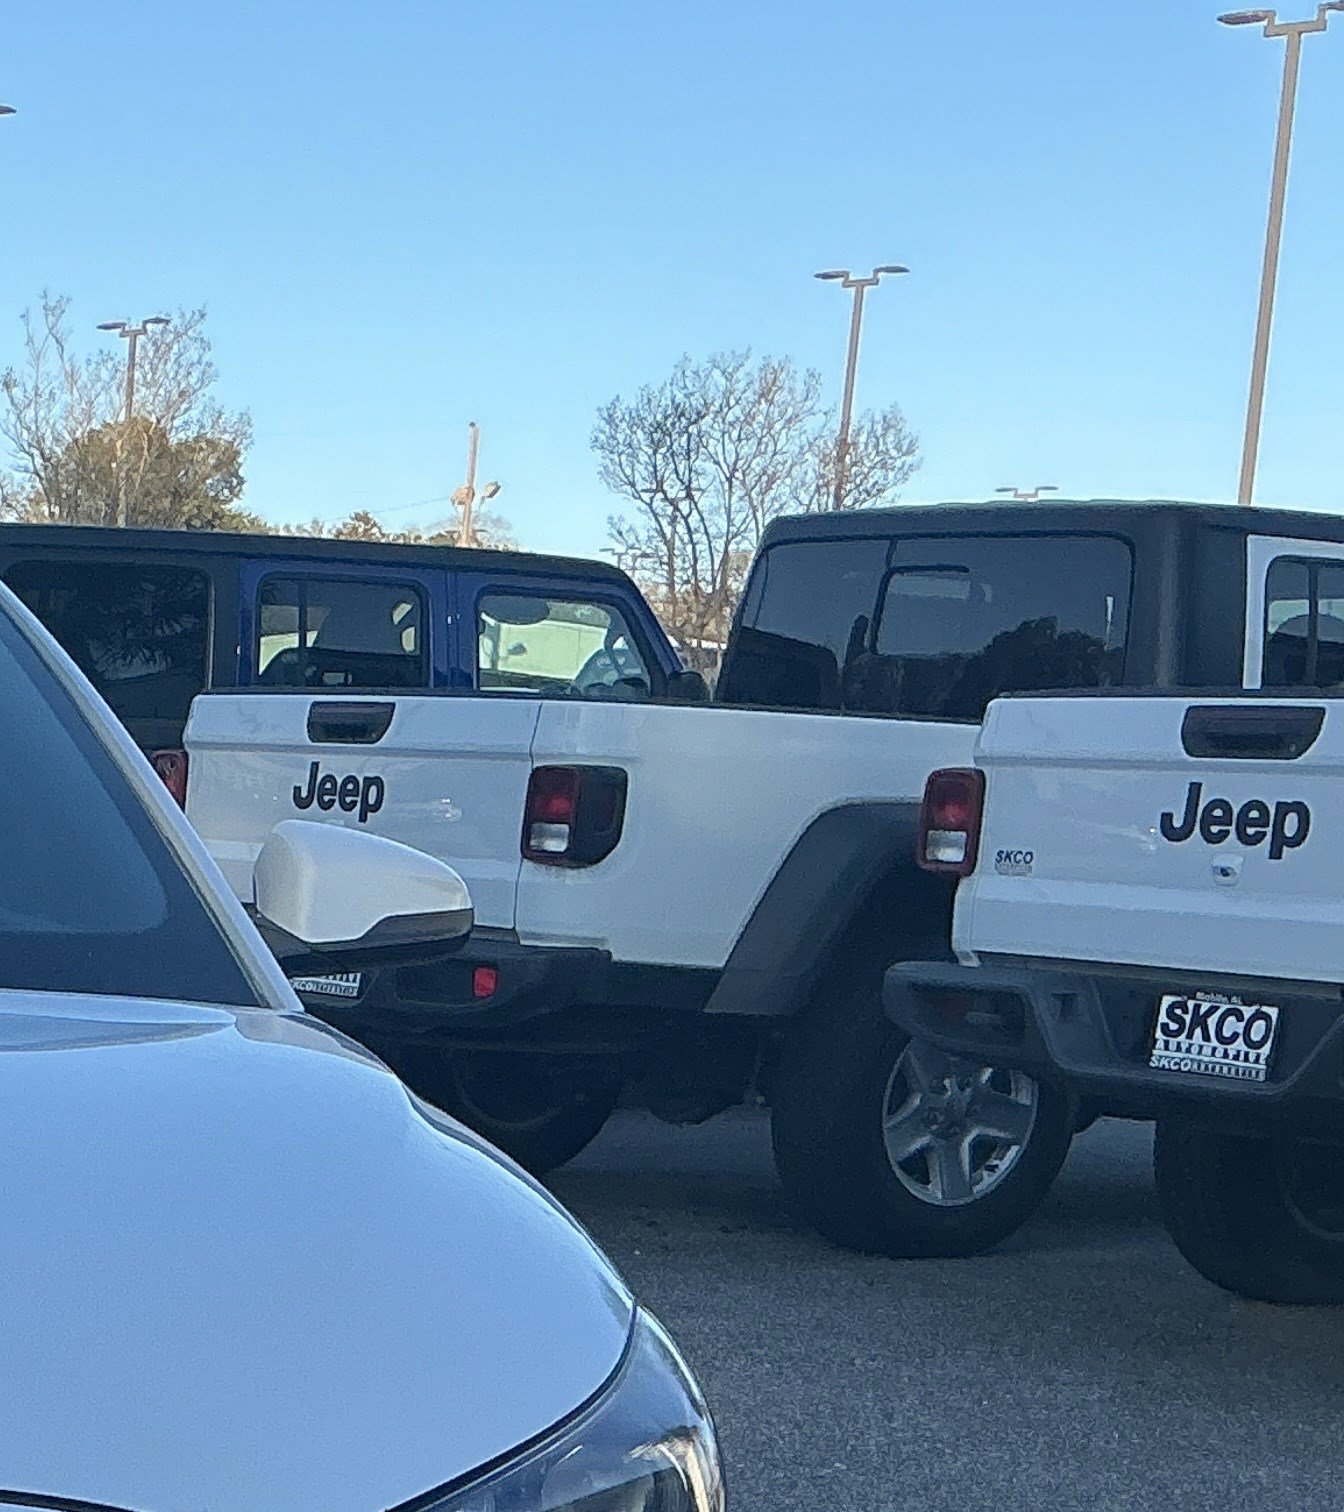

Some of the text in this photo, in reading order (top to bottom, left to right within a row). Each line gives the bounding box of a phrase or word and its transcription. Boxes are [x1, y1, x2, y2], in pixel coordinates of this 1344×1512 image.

[293, 761, 385, 823] Jeep
[1160, 781, 1311, 860] Jeep
[995, 849, 1034, 865] SKCO
[1160, 999, 1273, 1051] SKCO
[1155, 1038, 1267, 1066] AUTOMOTIVE
